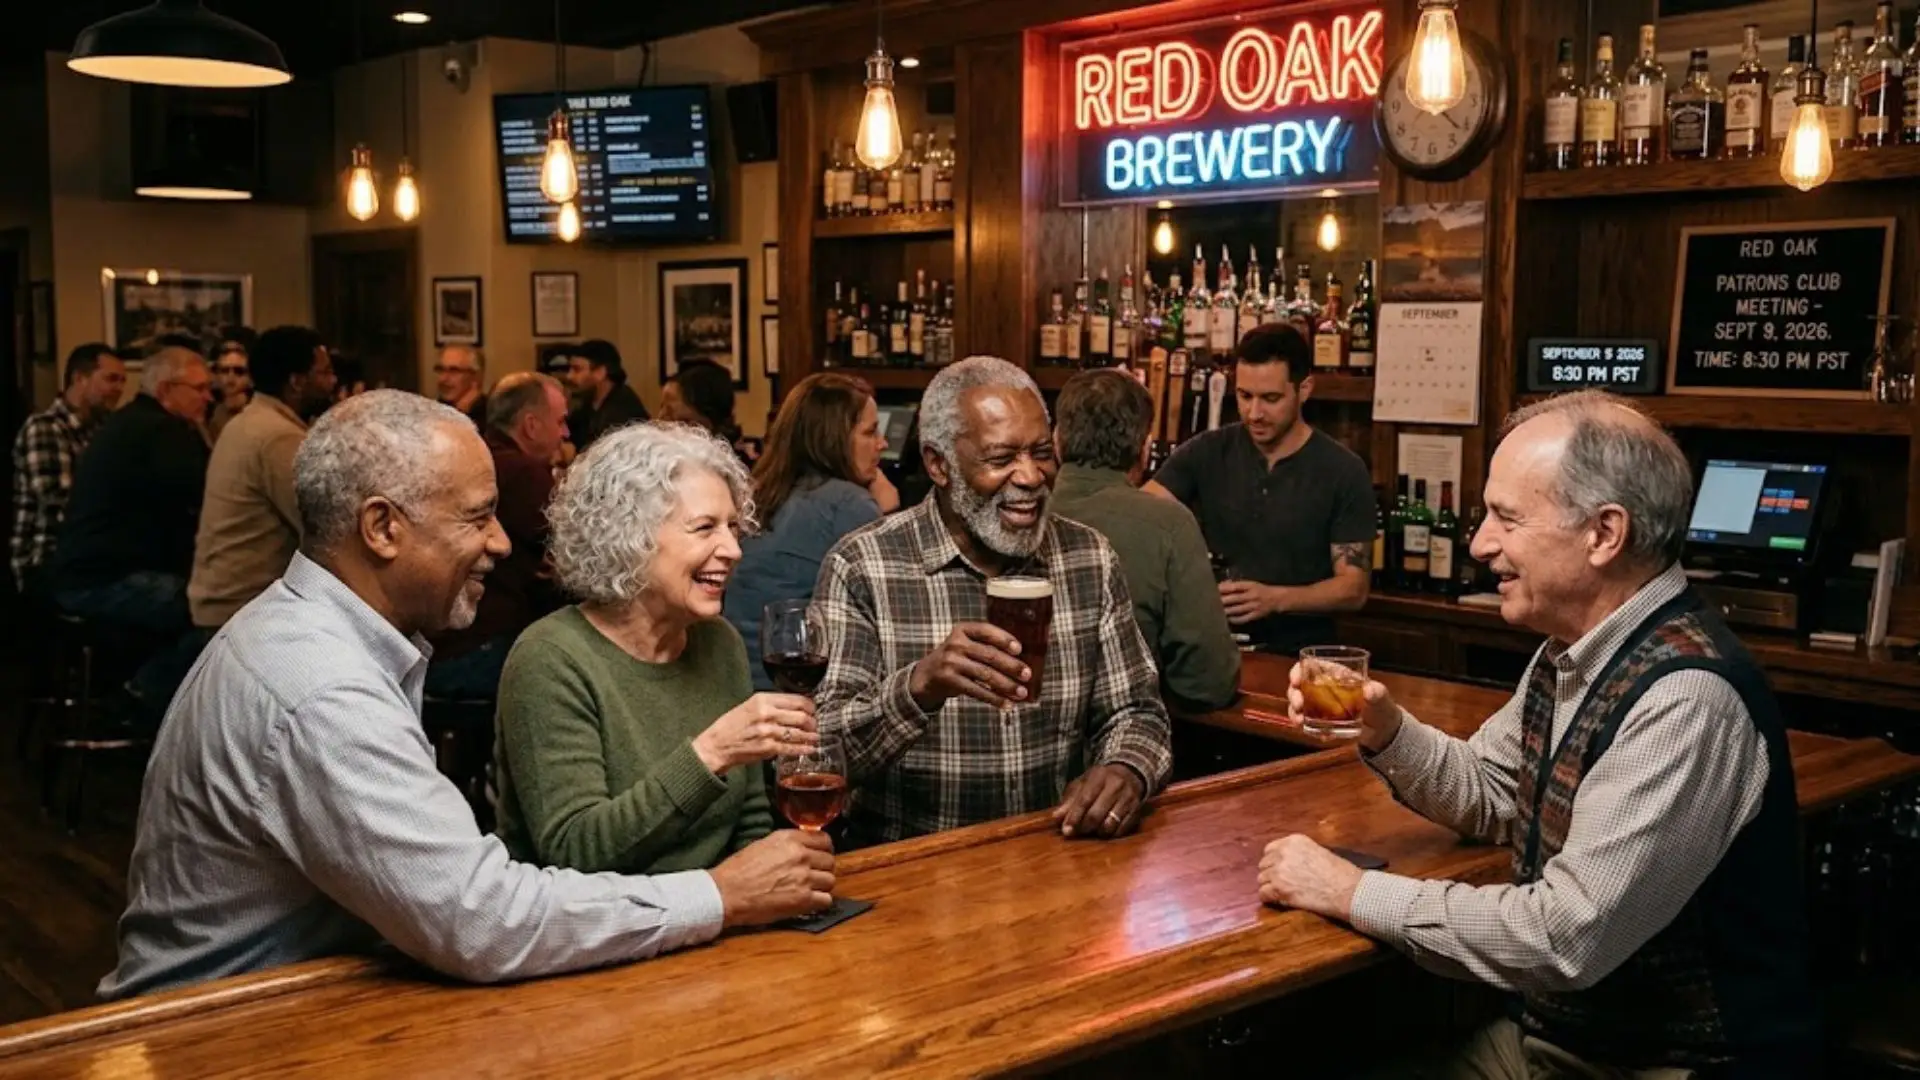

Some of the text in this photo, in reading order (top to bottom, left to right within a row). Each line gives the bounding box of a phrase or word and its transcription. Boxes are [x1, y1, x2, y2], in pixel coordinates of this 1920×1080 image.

[1075, 10, 1382, 130] RED OAK
[1105, 116, 1342, 191] BREWERY
[1739, 237, 1819, 258] RED OAK
[1715, 272, 1842, 292] PATRONS CLUB
[1401, 308, 1459, 320] SEPTEMBER
[1735, 298, 1809, 316] MEETING
[1714, 322, 1757, 341] SEPT
[1542, 347, 1601, 360] SEPTEMBER
[1694, 351, 1850, 370] TIME: 8:30 PM PST
[1586, 365, 1607, 382] PM
[1612, 365, 1641, 383] PST
